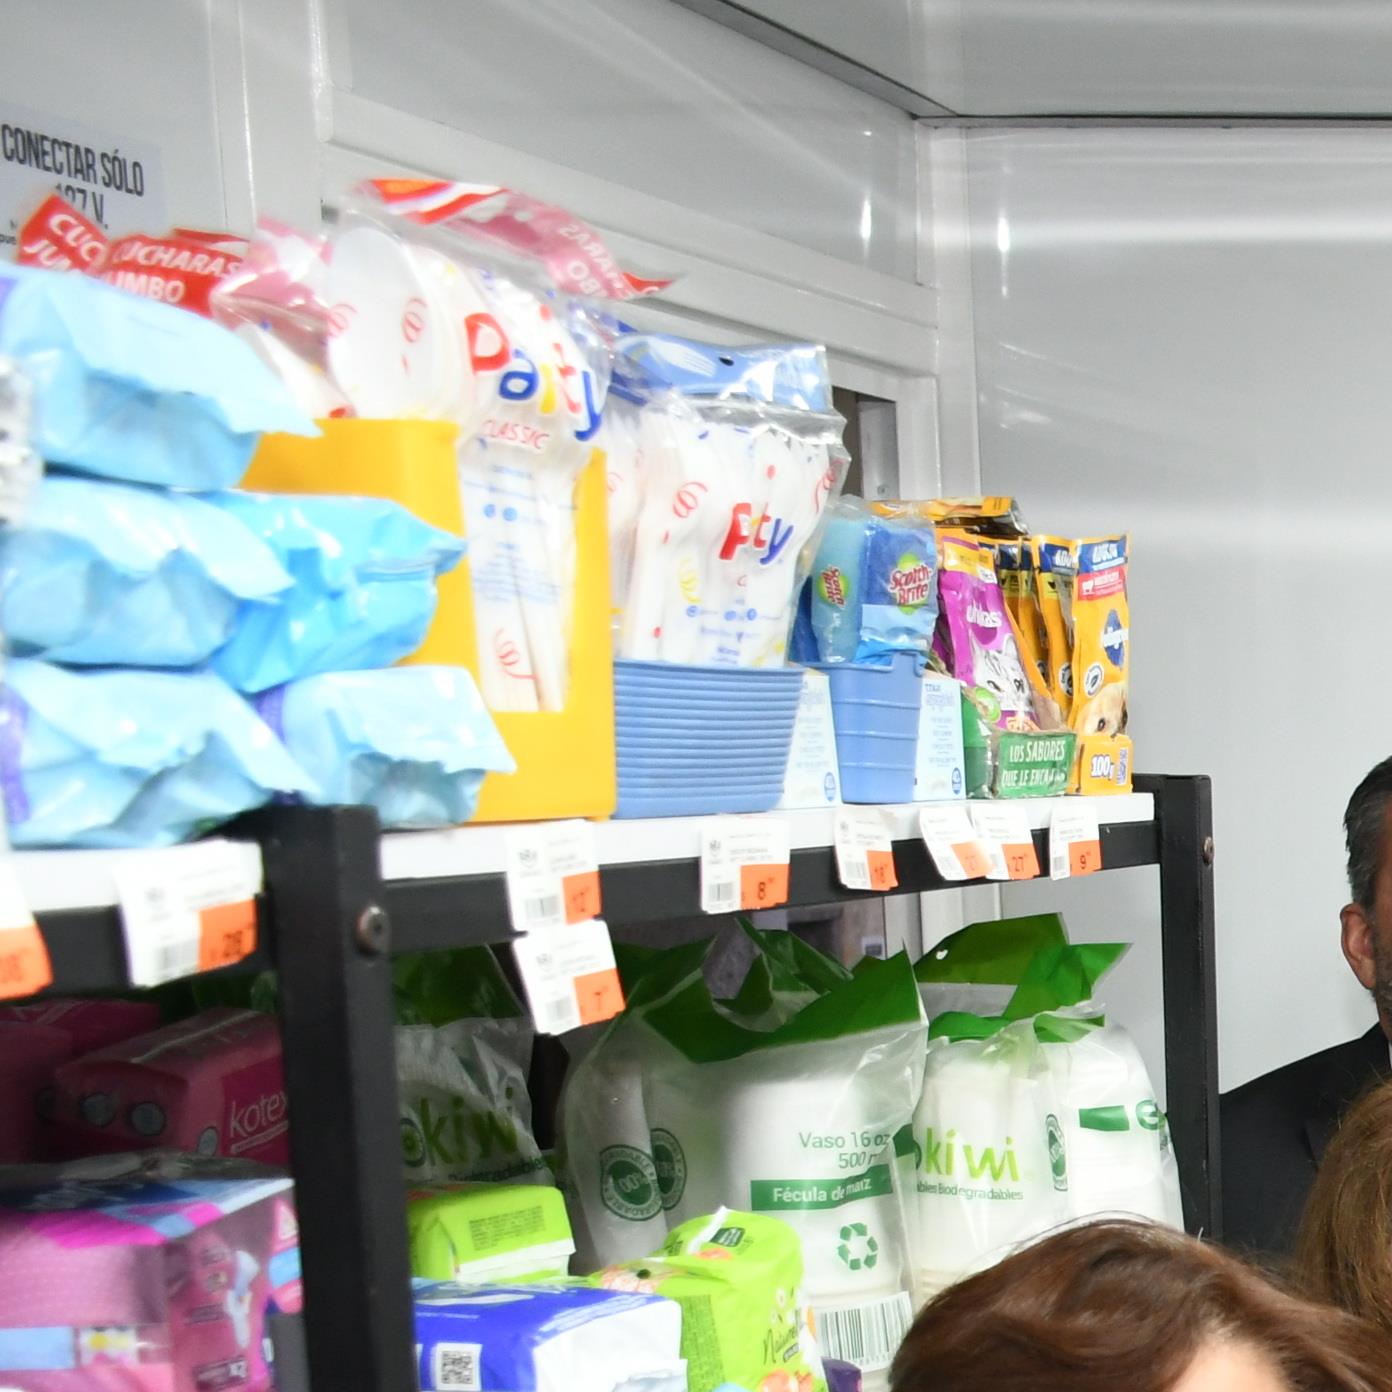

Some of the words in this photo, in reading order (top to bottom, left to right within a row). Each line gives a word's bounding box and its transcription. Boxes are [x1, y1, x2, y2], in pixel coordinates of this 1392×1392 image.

[1, 123, 97, 184] CONECTAR
[100, 148, 145, 197] SÓLO
[1010, 744, 1024, 764] LOS
[1026, 740, 1066, 763] SABORES
[799, 1131, 845, 1149] Vaso
[853, 1130, 871, 1148] 16
[925, 1127, 1020, 1183] kiwi
[773, 1185, 828, 1204] Fécula
